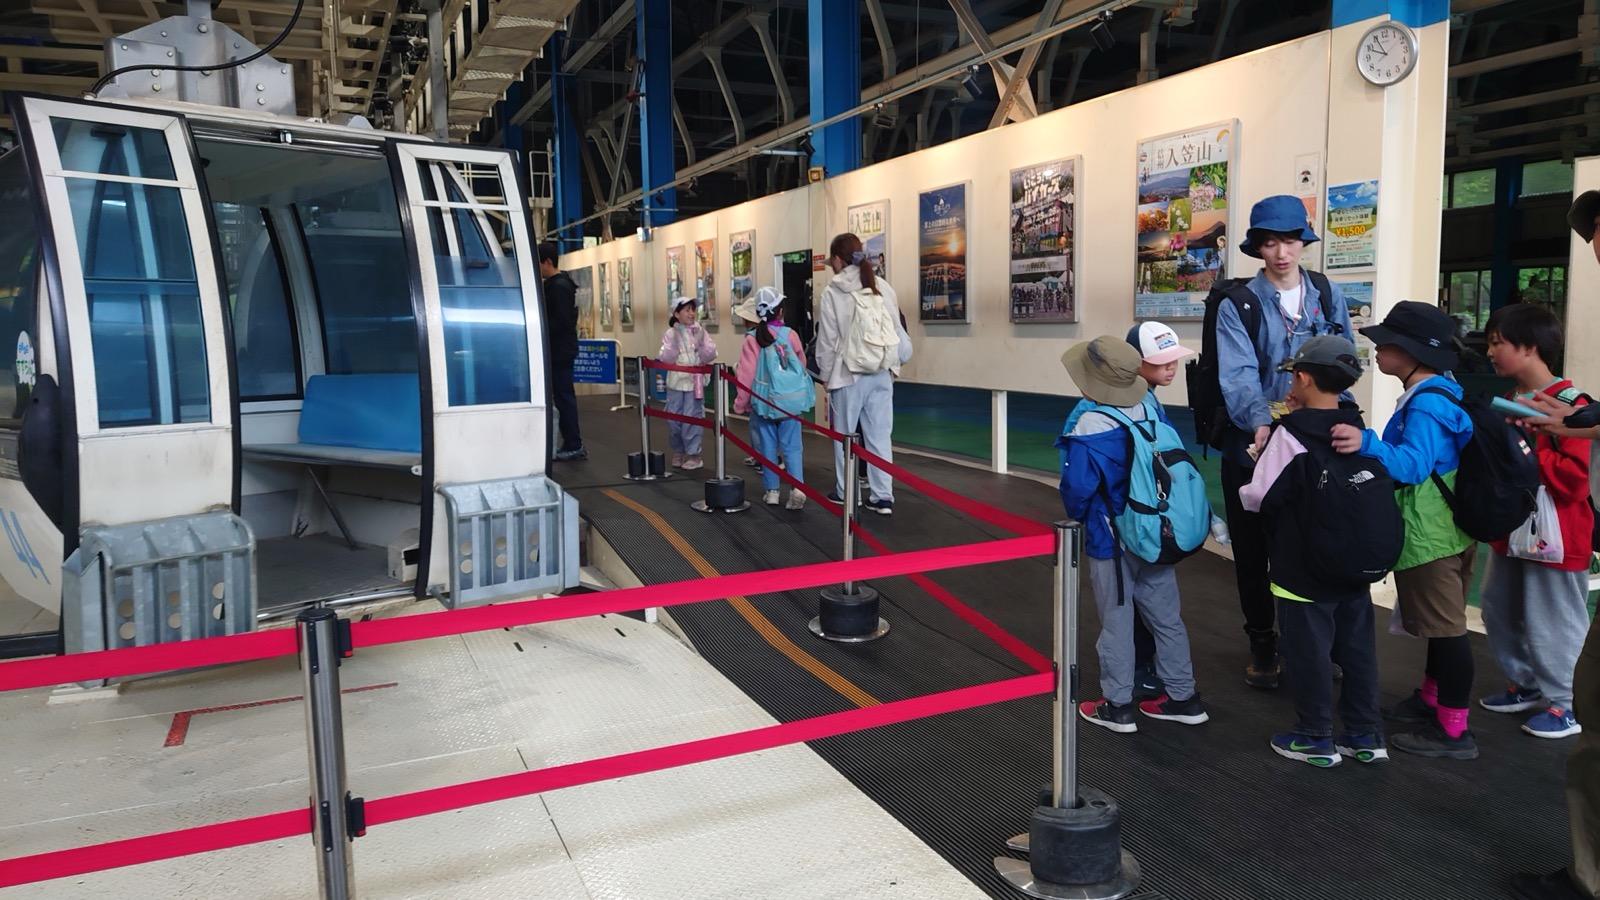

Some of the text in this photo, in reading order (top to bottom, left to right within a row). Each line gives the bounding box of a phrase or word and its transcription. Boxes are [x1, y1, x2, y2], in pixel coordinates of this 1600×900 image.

[1381, 29, 1389, 38] 12
[1399, 36, 1405, 45] 2
[1403, 46, 1408, 54] 3
[1366, 54, 1371, 62] 9
[1369, 63, 1375, 71] 8
[1395, 65, 1400, 73] 5
[1376, 68, 1381, 77] 7
[1386, 69, 1391, 78] 6
[1165, 140, 1211, 168] 入笠山
[855, 210, 881, 234] 入笠山
[1336, 224, 1366, 237] ¥1,500
